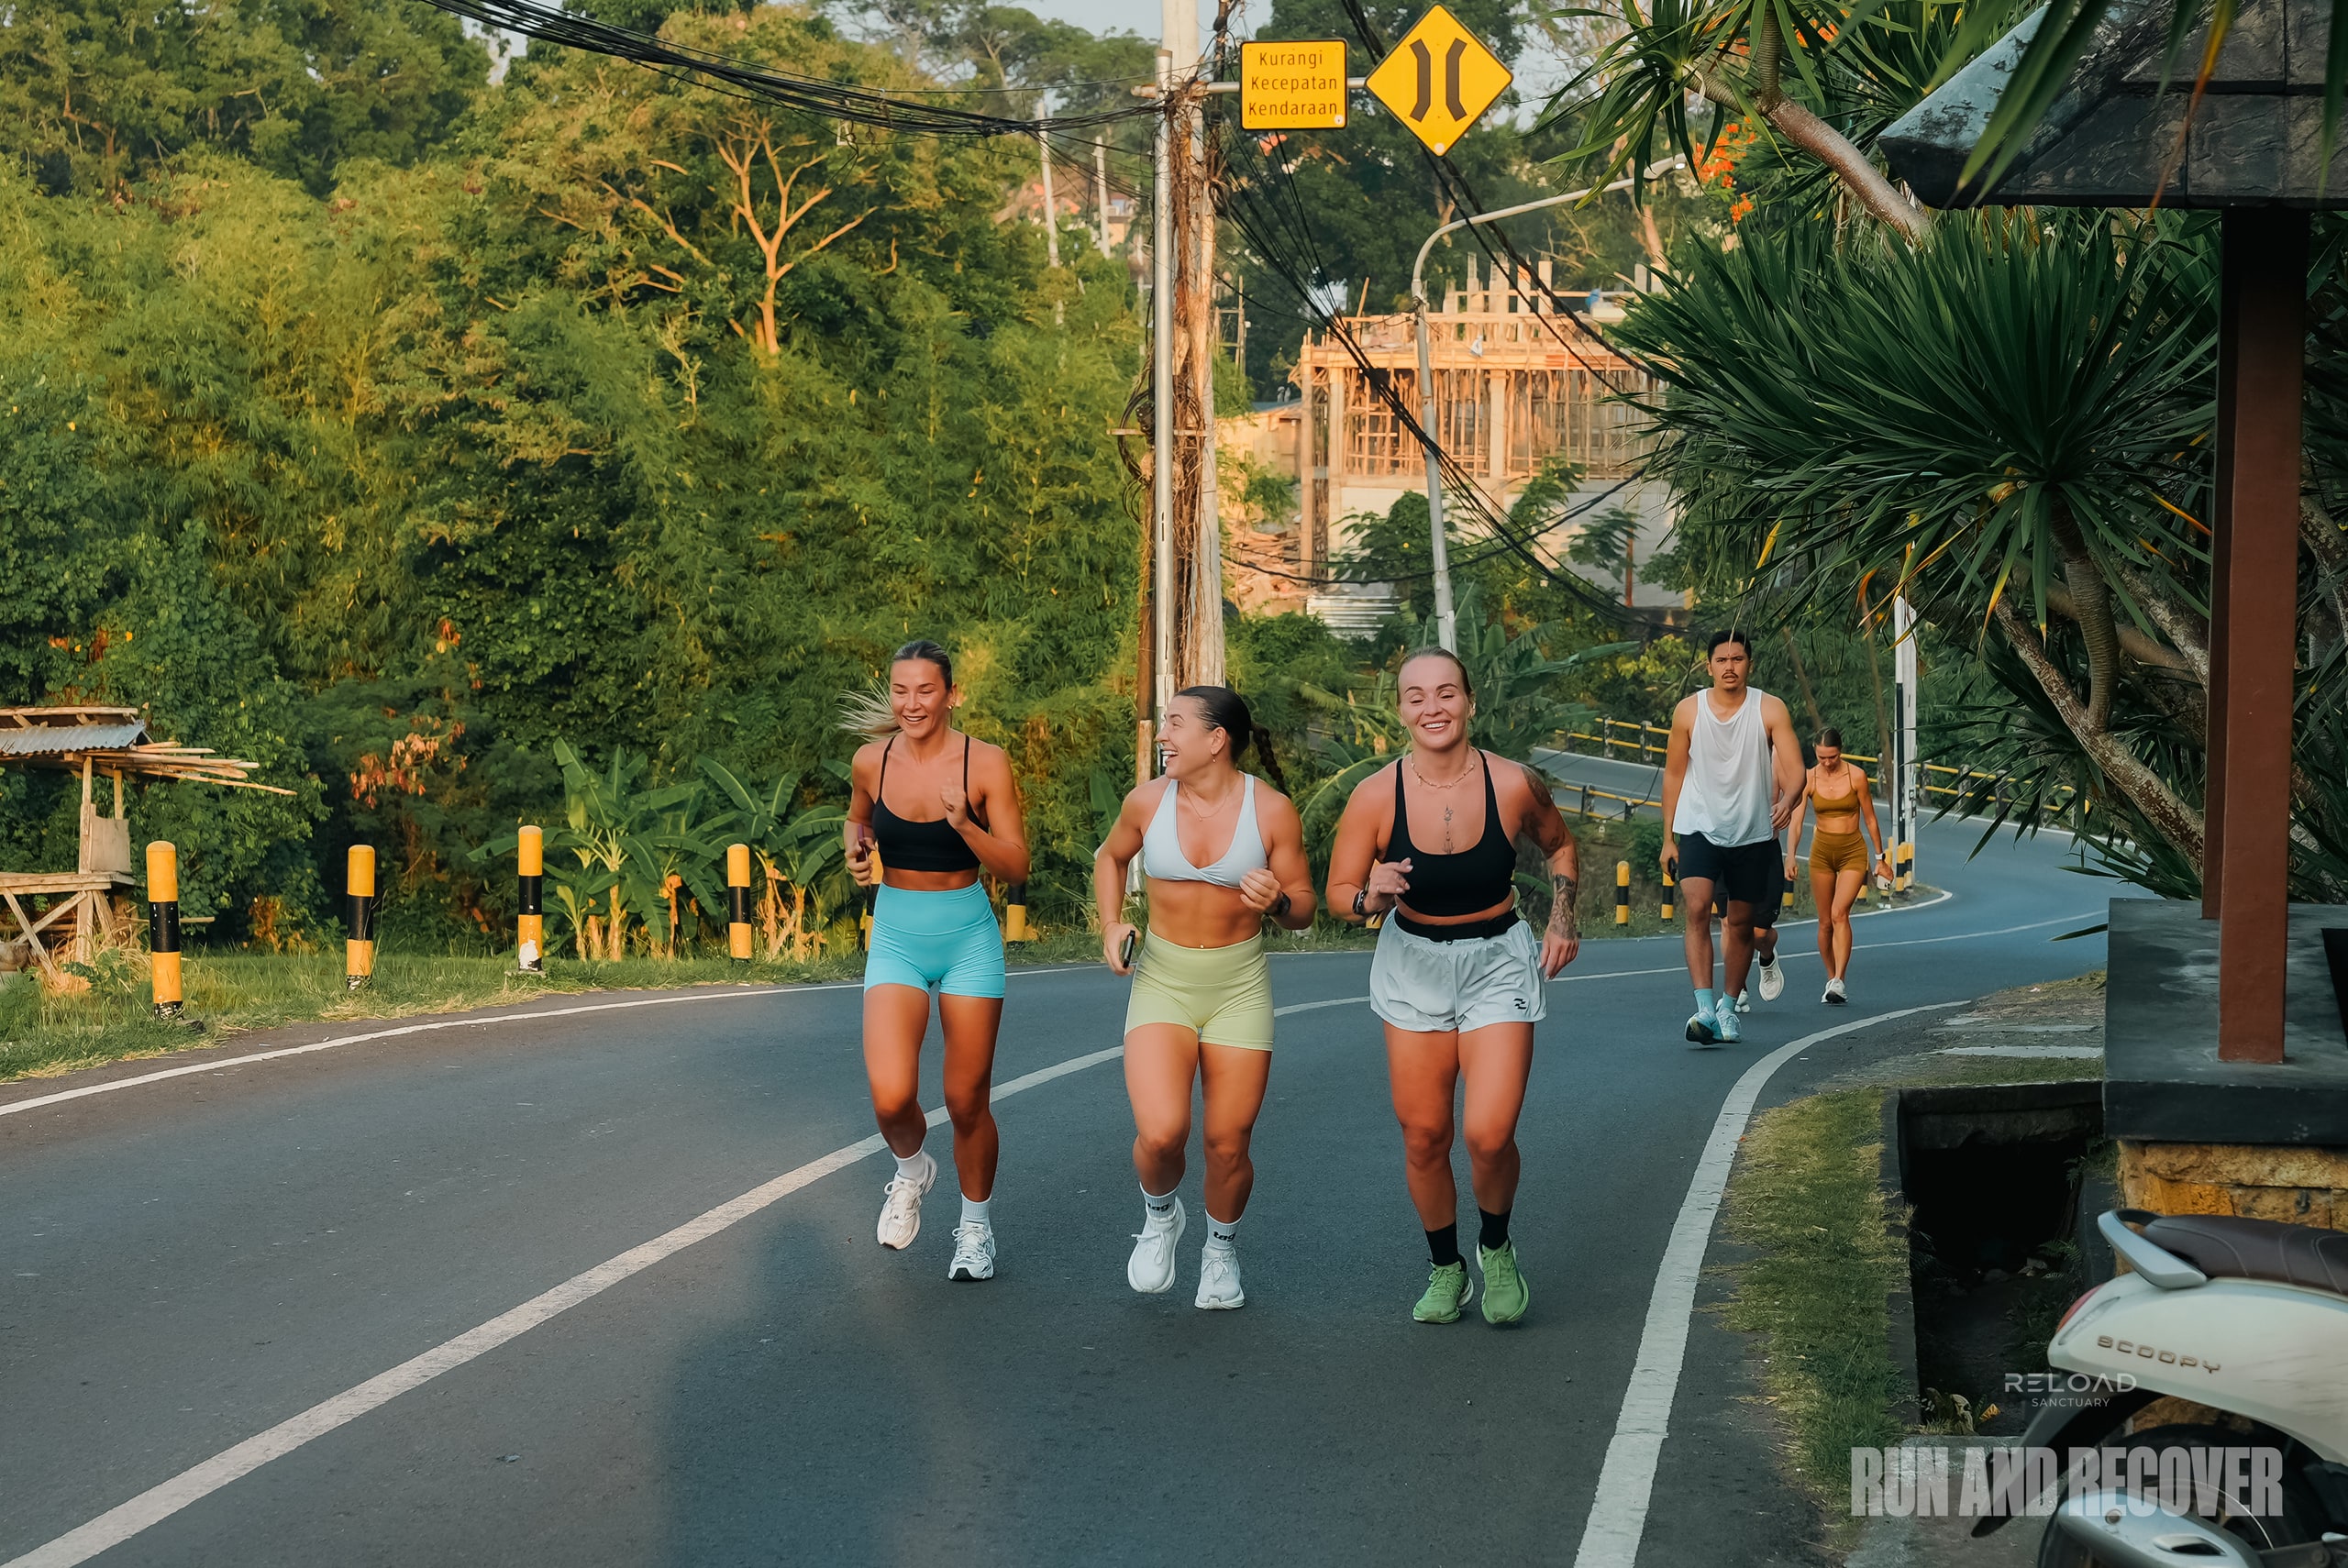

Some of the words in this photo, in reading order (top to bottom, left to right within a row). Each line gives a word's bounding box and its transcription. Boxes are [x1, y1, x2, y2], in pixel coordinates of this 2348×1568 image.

[1259, 50, 1323, 69] Kurangi
[1251, 76, 1337, 94] Kecepatan
[1248, 101, 1337, 116] Kendaraan
[2097, 1335, 2221, 1374] SCOOPY
